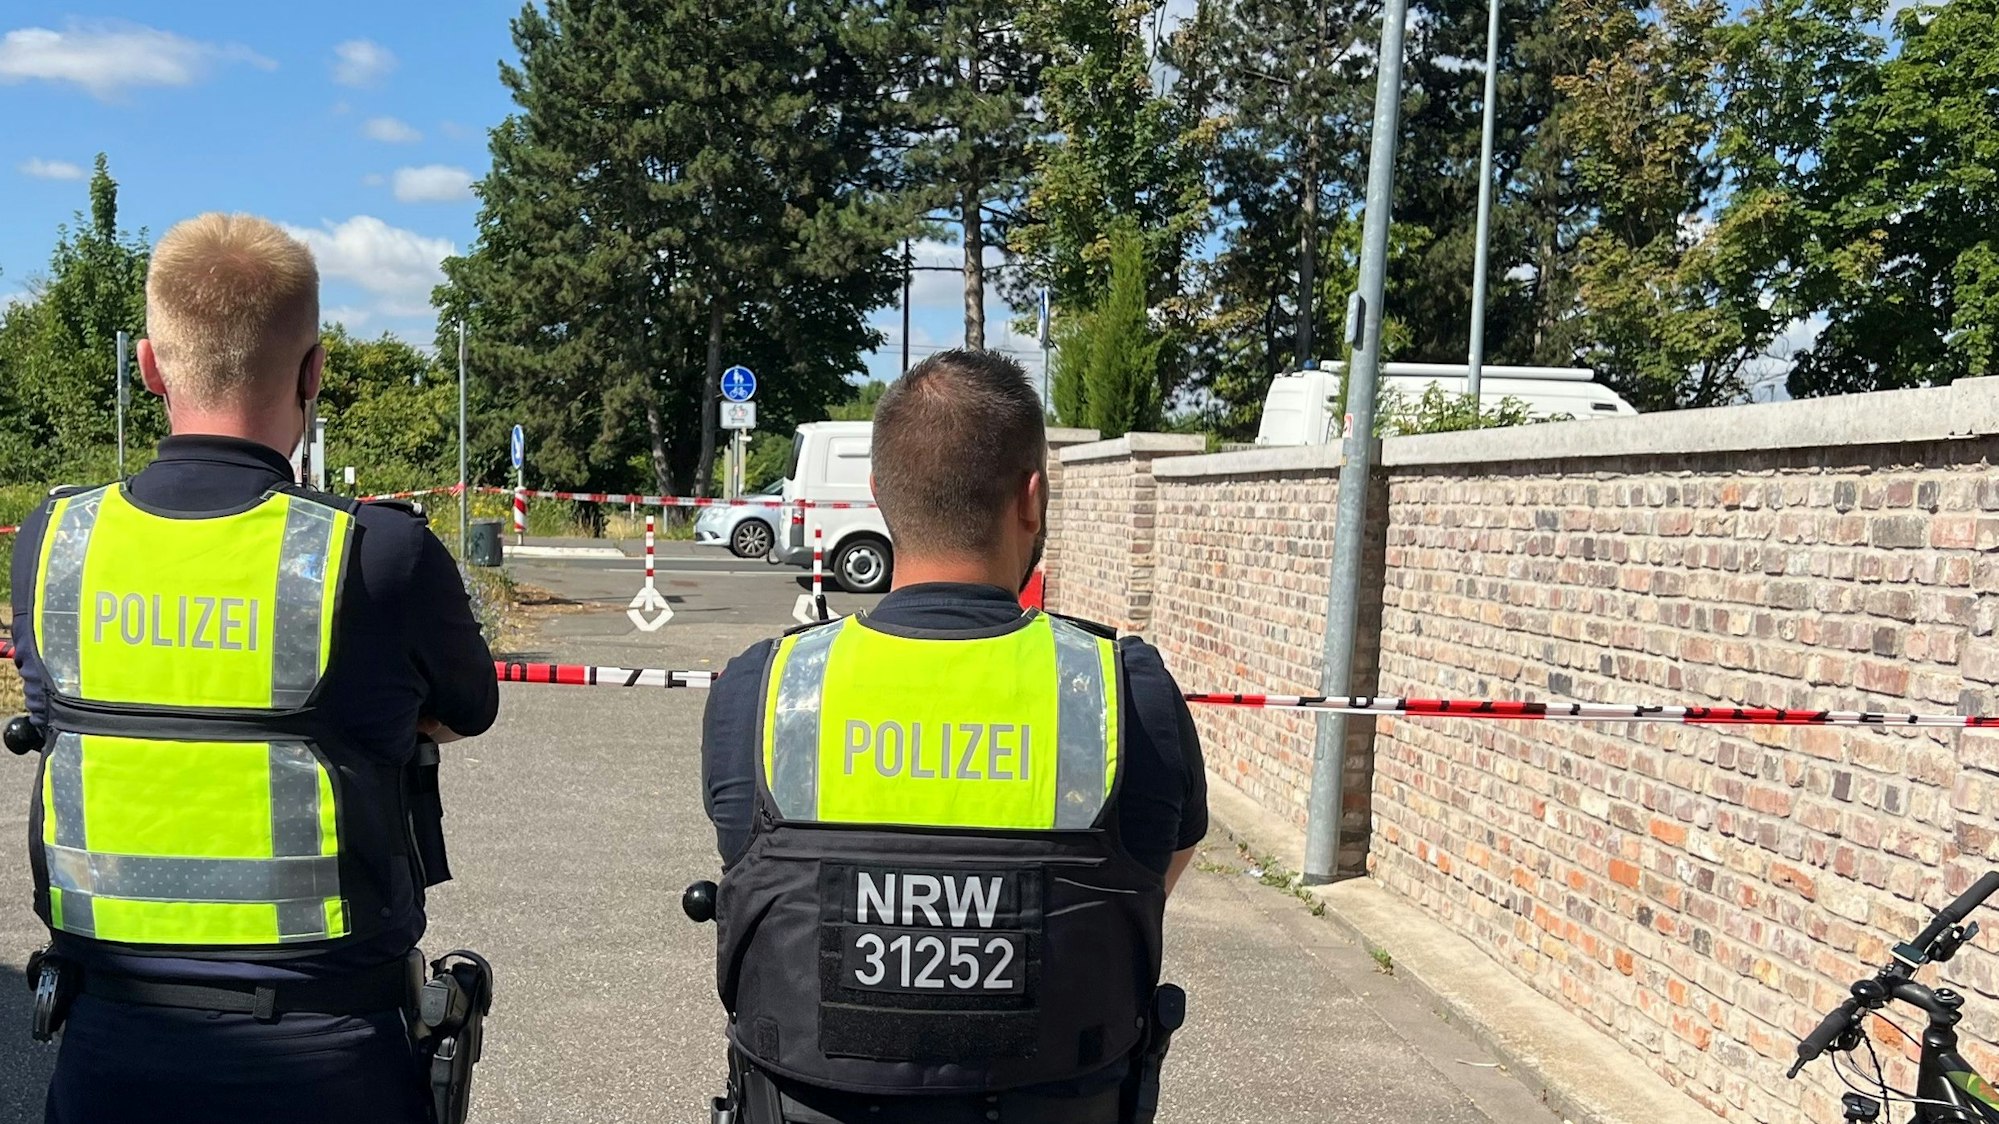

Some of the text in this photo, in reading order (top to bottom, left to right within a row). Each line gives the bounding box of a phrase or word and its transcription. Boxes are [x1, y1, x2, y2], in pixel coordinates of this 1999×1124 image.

[94, 591, 258, 651] POLIZEI
[843, 719, 1030, 780] POLIZEI
[856, 872, 1003, 928] NRW
[854, 933, 1014, 989] 31252
